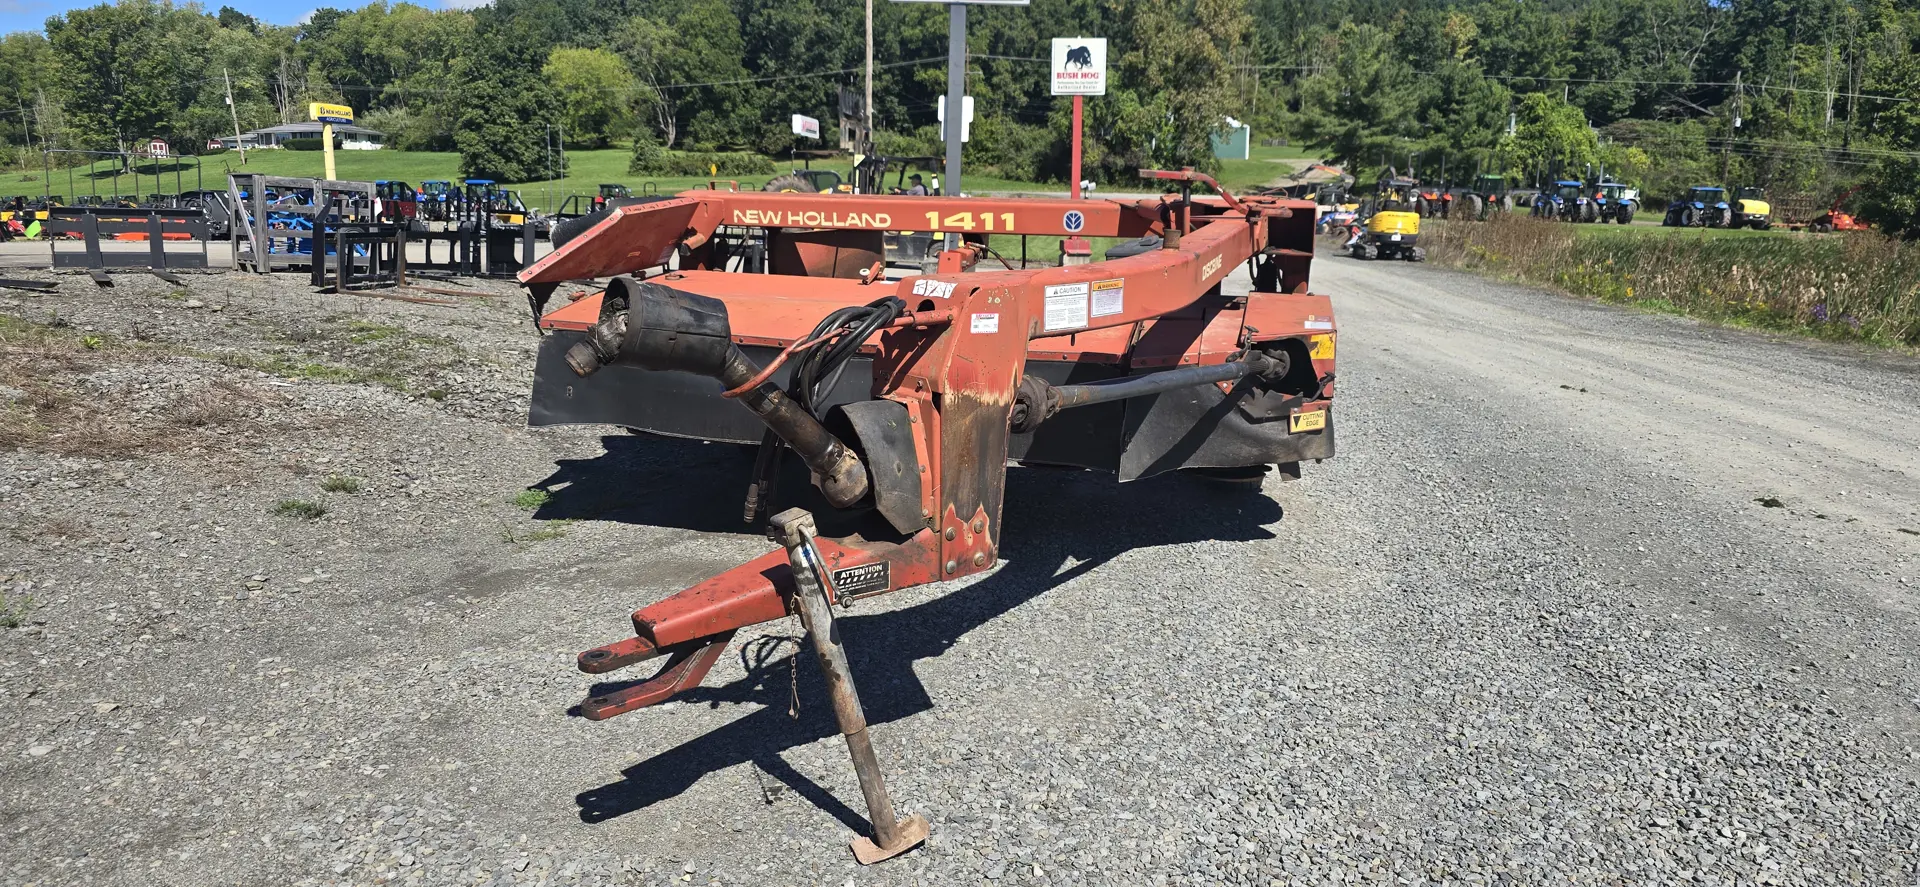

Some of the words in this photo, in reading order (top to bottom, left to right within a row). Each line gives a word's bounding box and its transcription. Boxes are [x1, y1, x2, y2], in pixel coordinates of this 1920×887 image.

[733, 209, 782, 225] NEW
[787, 211, 892, 228] HOLLAND
[925, 211, 1015, 231] 1411
[1302, 412, 1324, 420] CUTTING
[840, 564, 883, 579] ATTENTION
